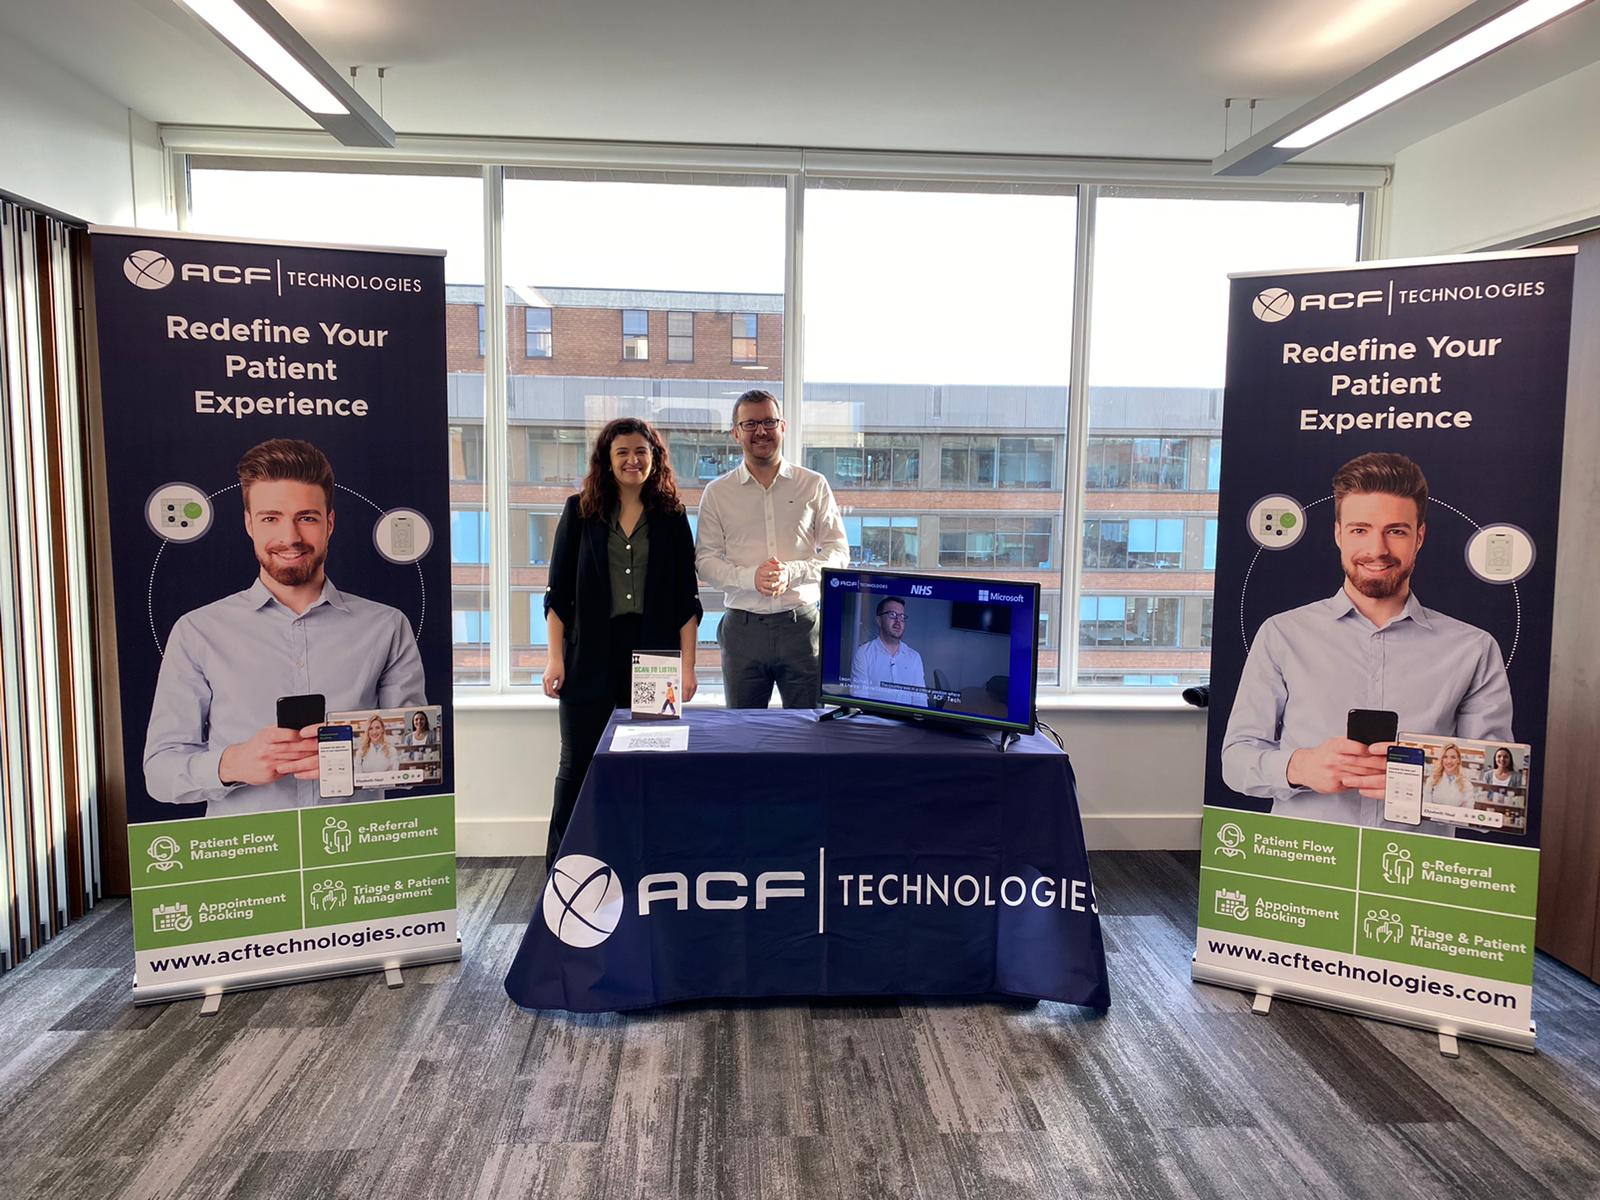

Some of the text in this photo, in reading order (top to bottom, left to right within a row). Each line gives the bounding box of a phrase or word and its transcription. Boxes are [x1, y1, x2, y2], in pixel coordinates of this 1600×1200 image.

[181, 263, 423, 293] ACF TECHNOLOGIES
[1300, 281, 1546, 311] ACF TECHNOLOGIES
[166, 315, 389, 347] Redefine Your
[1282, 336, 1502, 364] Redefine Your
[225, 354, 338, 381] Patient
[1331, 371, 1442, 396] Patient
[194, 390, 369, 418] Experience
[1300, 407, 1473, 435] Experience
[910, 584, 932, 596] NHS
[990, 592, 1024, 602] Microsoft
[358, 818, 418, 834] e-Referral
[358, 827, 438, 844] Management
[190, 833, 275, 850] Patient Flow
[190, 842, 279, 861] Management
[1254, 833, 1334, 854] Patient Flow
[1254, 844, 1337, 866] Management
[1421, 859, 1493, 879] e-Referral
[352, 876, 450, 896] Triage & Patient
[638, 871, 805, 915] ACF
[1421, 869, 1517, 894] Management
[198, 893, 287, 914] Appointment
[353, 888, 433, 906] Management
[1255, 897, 1340, 921] Appointment
[199, 908, 254, 924] Booking
[1254, 908, 1306, 928] Booking
[149, 918, 446, 973] www.acftechnologies.com
[1410, 924, 1527, 955] Triage & Patient
[1410, 936, 1504, 961] Management
[1208, 938, 1518, 1009] www.acftechnologies.com
